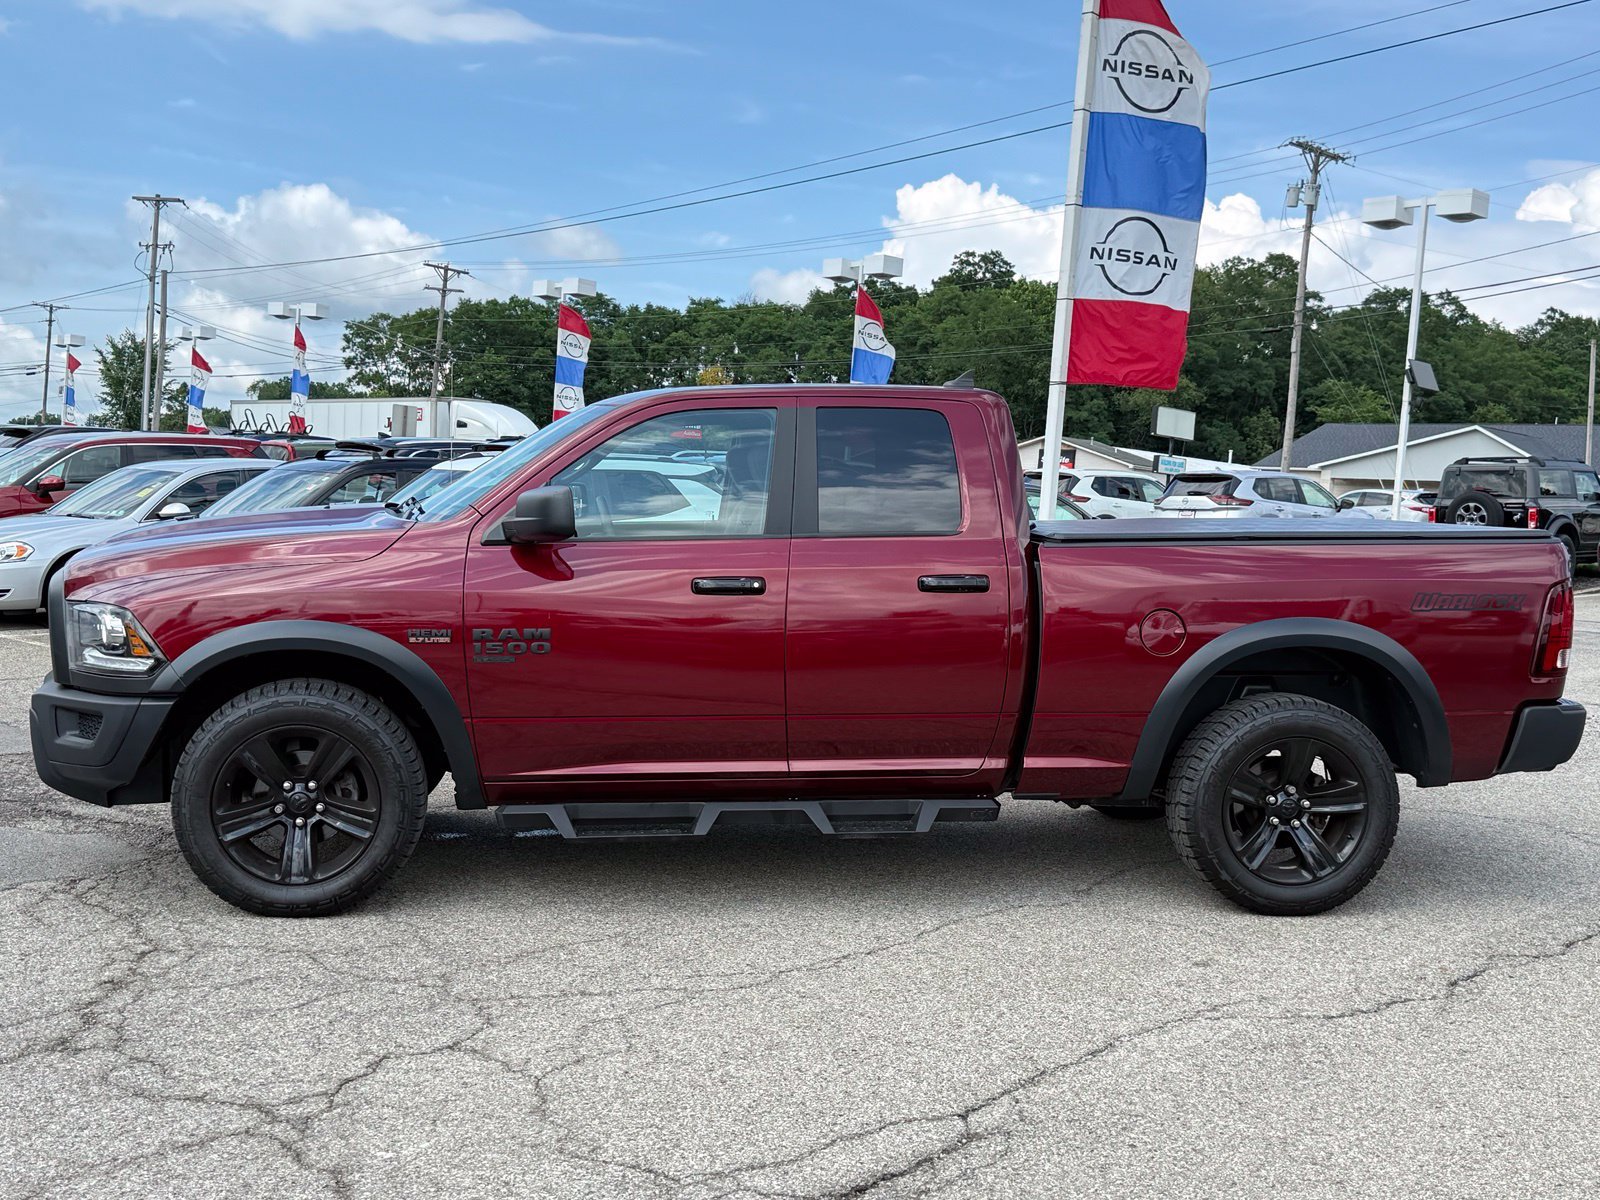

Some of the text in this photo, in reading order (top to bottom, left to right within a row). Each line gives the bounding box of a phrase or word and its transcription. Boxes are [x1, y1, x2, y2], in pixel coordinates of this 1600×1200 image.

[1102, 58, 1195, 85] NISSAN
[1090, 246, 1178, 271] NISSAN
[858, 330, 885, 342] NISSA
[407, 628, 452, 638] HEMI
[472, 628, 551, 640] RAM
[473, 642, 551, 655] 1500
